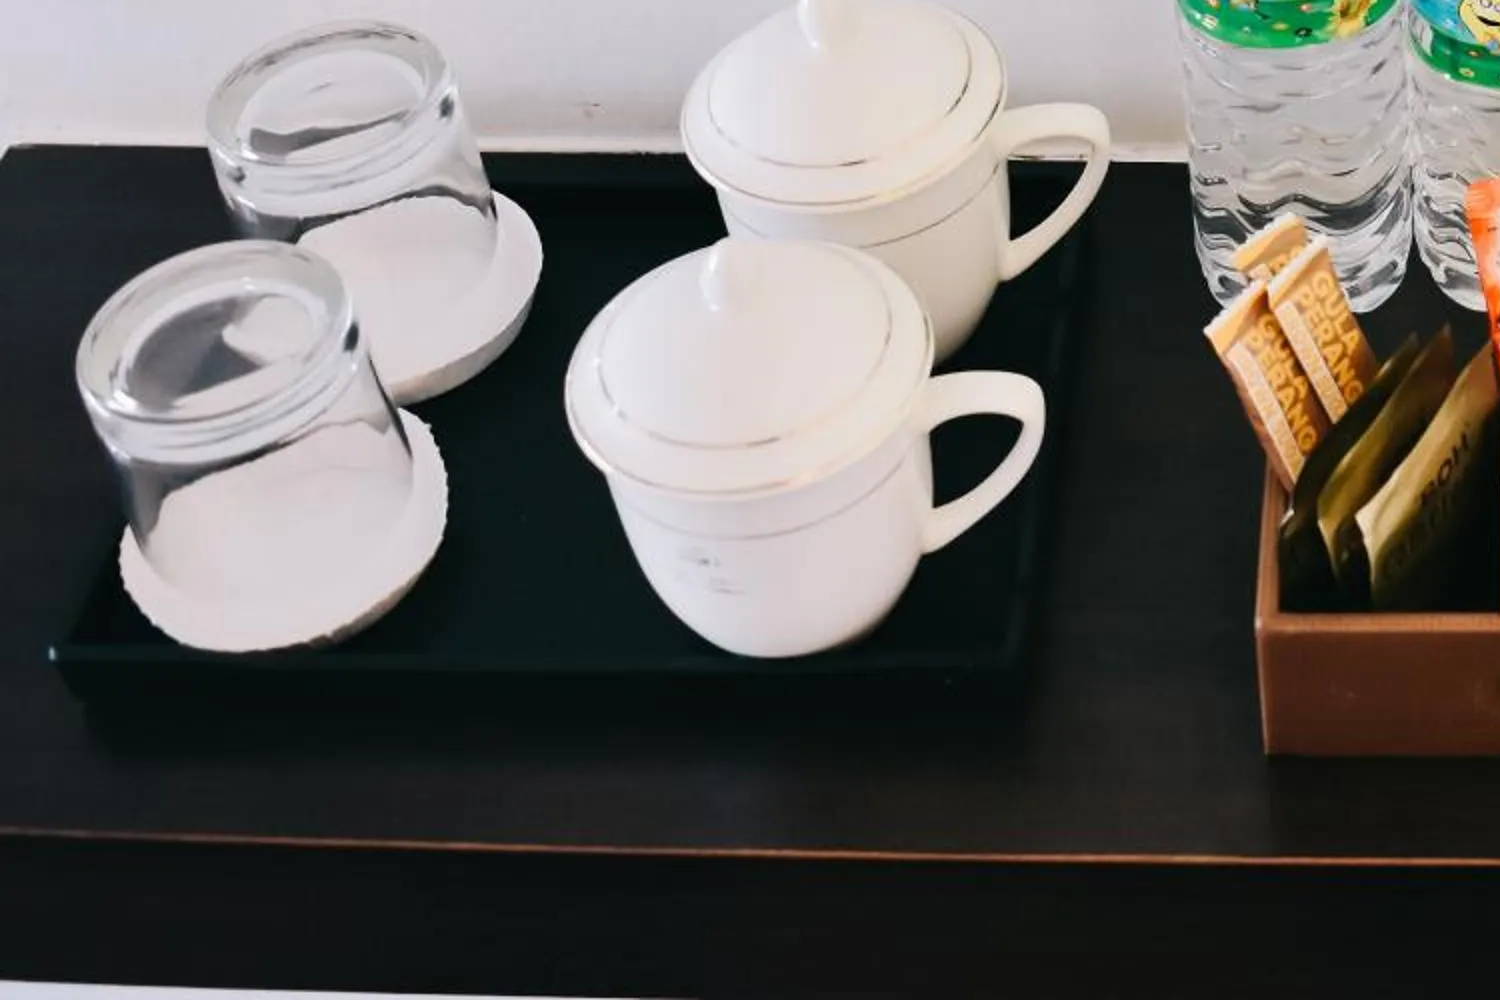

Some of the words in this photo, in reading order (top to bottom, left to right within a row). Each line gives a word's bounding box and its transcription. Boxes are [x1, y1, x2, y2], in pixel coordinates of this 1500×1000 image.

[1257, 313, 1309, 398] GULA
[1298, 290, 1365, 403] PERANG
[1310, 269, 1361, 351] GULA
[1248, 326, 1319, 457] PERANG
